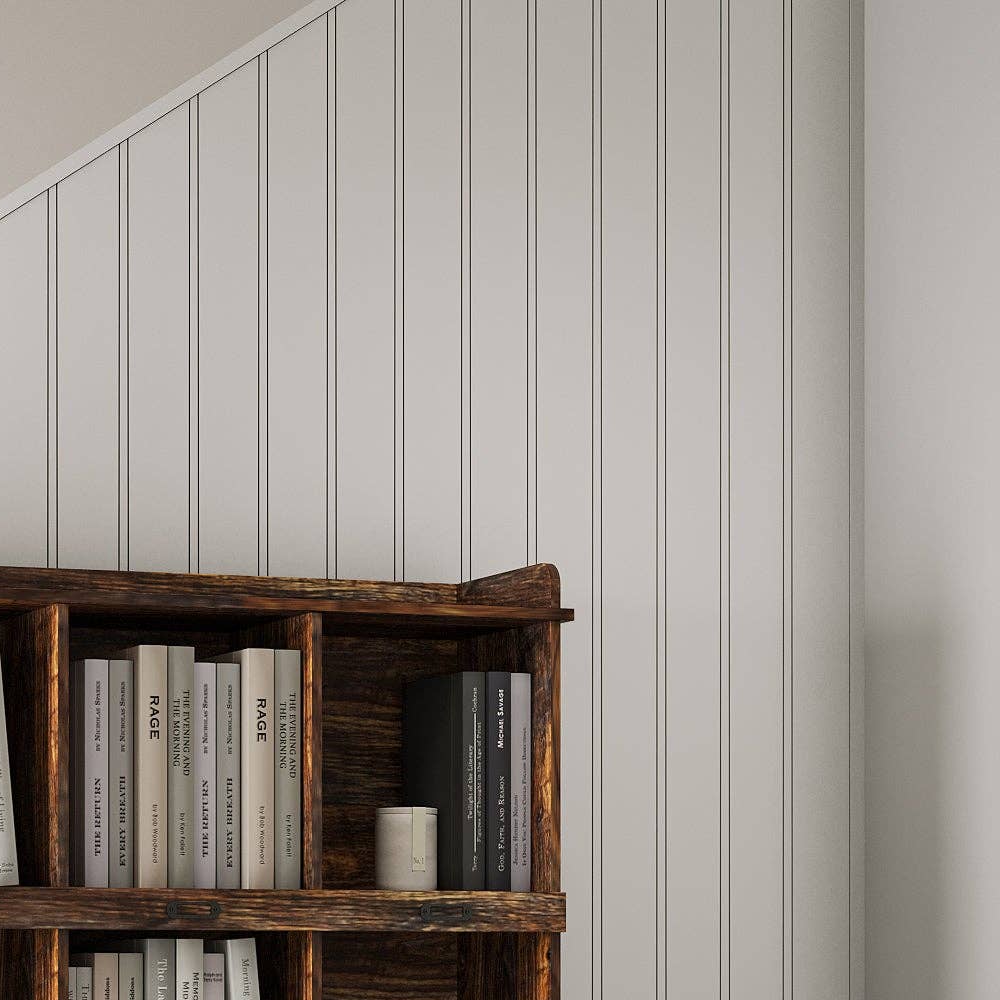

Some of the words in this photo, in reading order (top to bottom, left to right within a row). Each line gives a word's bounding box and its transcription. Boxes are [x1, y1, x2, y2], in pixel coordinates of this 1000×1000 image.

[150, 696, 160, 740] RAGE
[257, 698, 266, 742] RAGE
[158, 959, 167, 981] The
[241, 959, 250, 996] Morning
